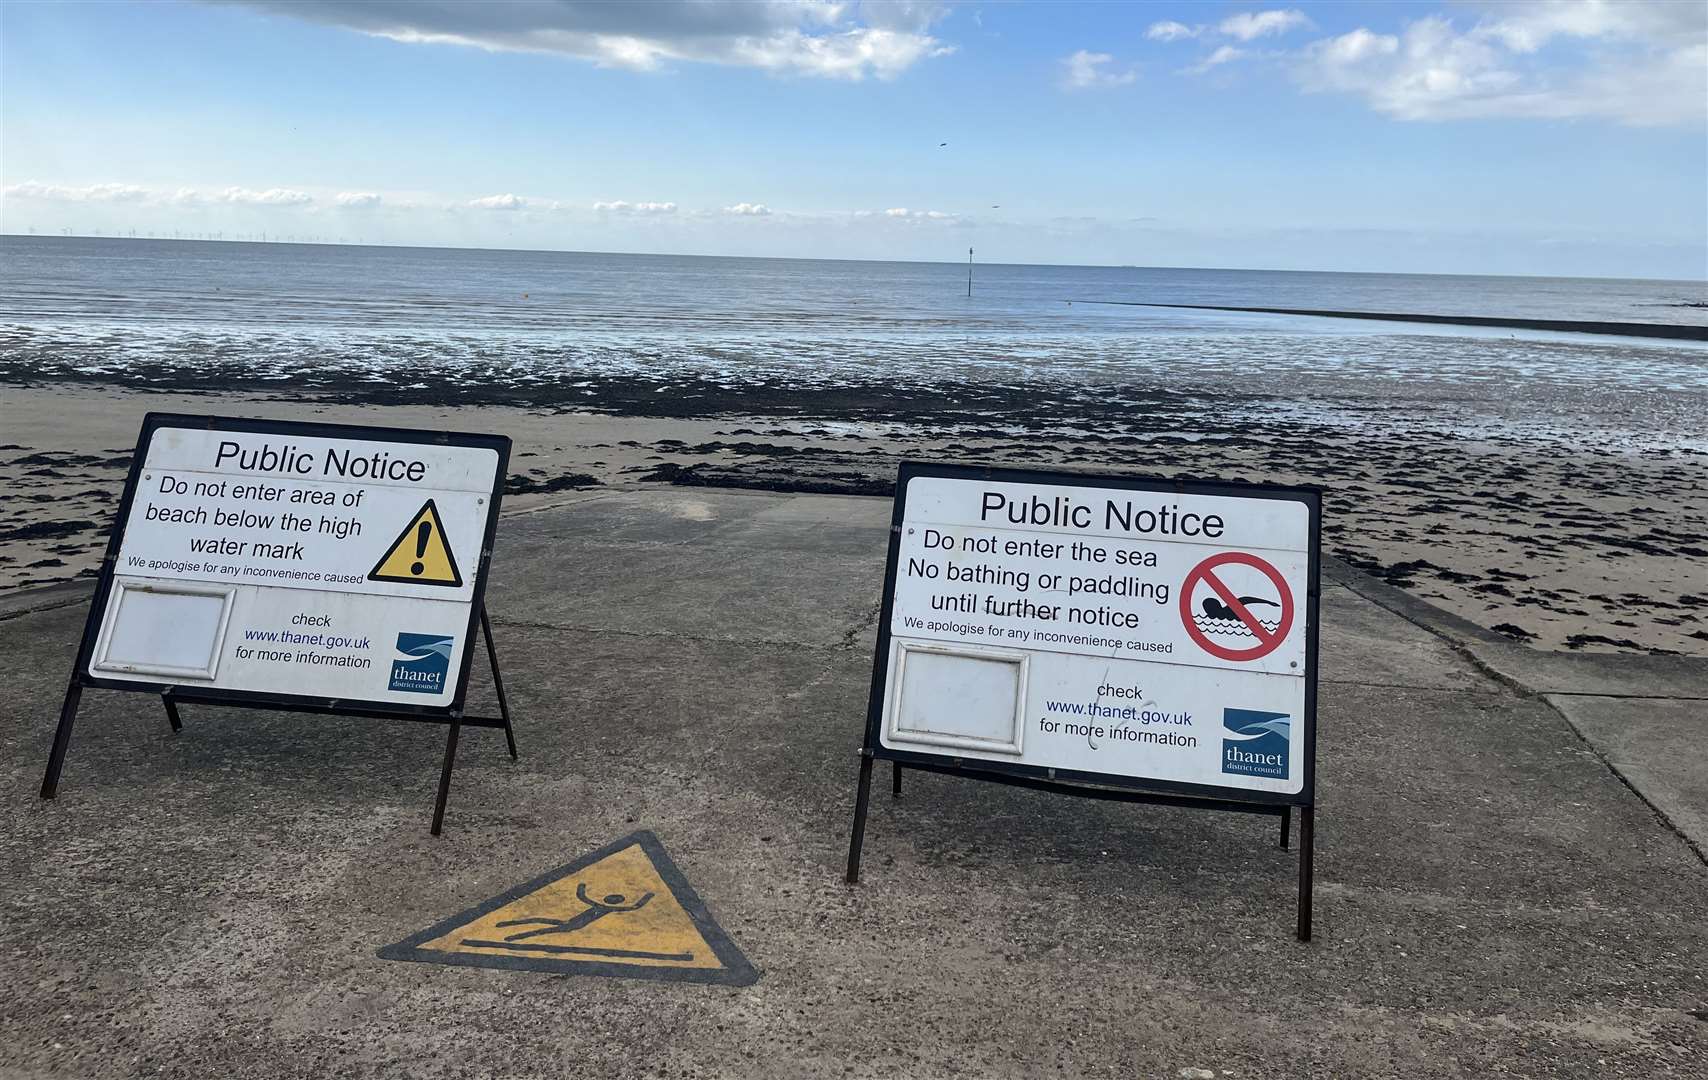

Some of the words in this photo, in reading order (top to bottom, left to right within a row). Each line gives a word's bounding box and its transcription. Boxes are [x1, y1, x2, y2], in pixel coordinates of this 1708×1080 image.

[215, 441, 314, 474] Public
[323, 449, 426, 482] Notice
[159, 475, 188, 495] Do
[195, 482, 226, 498] not
[232, 483, 285, 501] enter
[290, 490, 335, 506] area
[343, 490, 364, 507] of
[145, 503, 207, 524] beach
[214, 508, 274, 530] below
[281, 512, 312, 532] the
[319, 516, 362, 540] high
[981, 492, 1091, 529] Public
[1105, 500, 1224, 538] Notice
[190, 538, 246, 556] water
[253, 542, 304, 561] mark
[924, 530, 954, 550] Do
[963, 535, 997, 554] not
[1005, 539, 1064, 559] enter
[1071, 542, 1107, 562] the
[1115, 550, 1157, 567] sea
[128, 556, 146, 568] We
[148, 559, 200, 574] apologise
[203, 562, 218, 572] for
[220, 565, 240, 577] any
[243, 566, 321, 581] inconvenience
[324, 572, 364, 584] caused
[908, 558, 939, 579] No
[947, 561, 1029, 591] bathing
[1038, 574, 1061, 590] or
[1068, 574, 1169, 604] paddling
[292, 613, 331, 627] check
[931, 593, 977, 614] until
[985, 595, 1061, 621] further
[1068, 605, 1139, 629] notice
[245, 629, 370, 650] www.thanet.gov.uk
[904, 617, 924, 629] We
[926, 619, 984, 637] apologise
[988, 624, 1005, 637] for
[1007, 628, 1030, 642] any
[1033, 630, 1123, 648] inconvenience
[1126, 638, 1173, 654] caused
[236, 646, 254, 659] for
[258, 651, 292, 662] more
[296, 651, 371, 669] information
[394, 667, 440, 683] thanet
[1097, 684, 1142, 700] check
[1047, 701, 1192, 726] www.thanet.gov.uk
[1040, 718, 1060, 732] for
[1065, 723, 1104, 738] more
[1109, 726, 1197, 748] information
[1226, 747, 1282, 766] thanet
[1227, 763, 1252, 772] district
[1254, 766, 1281, 775] council
